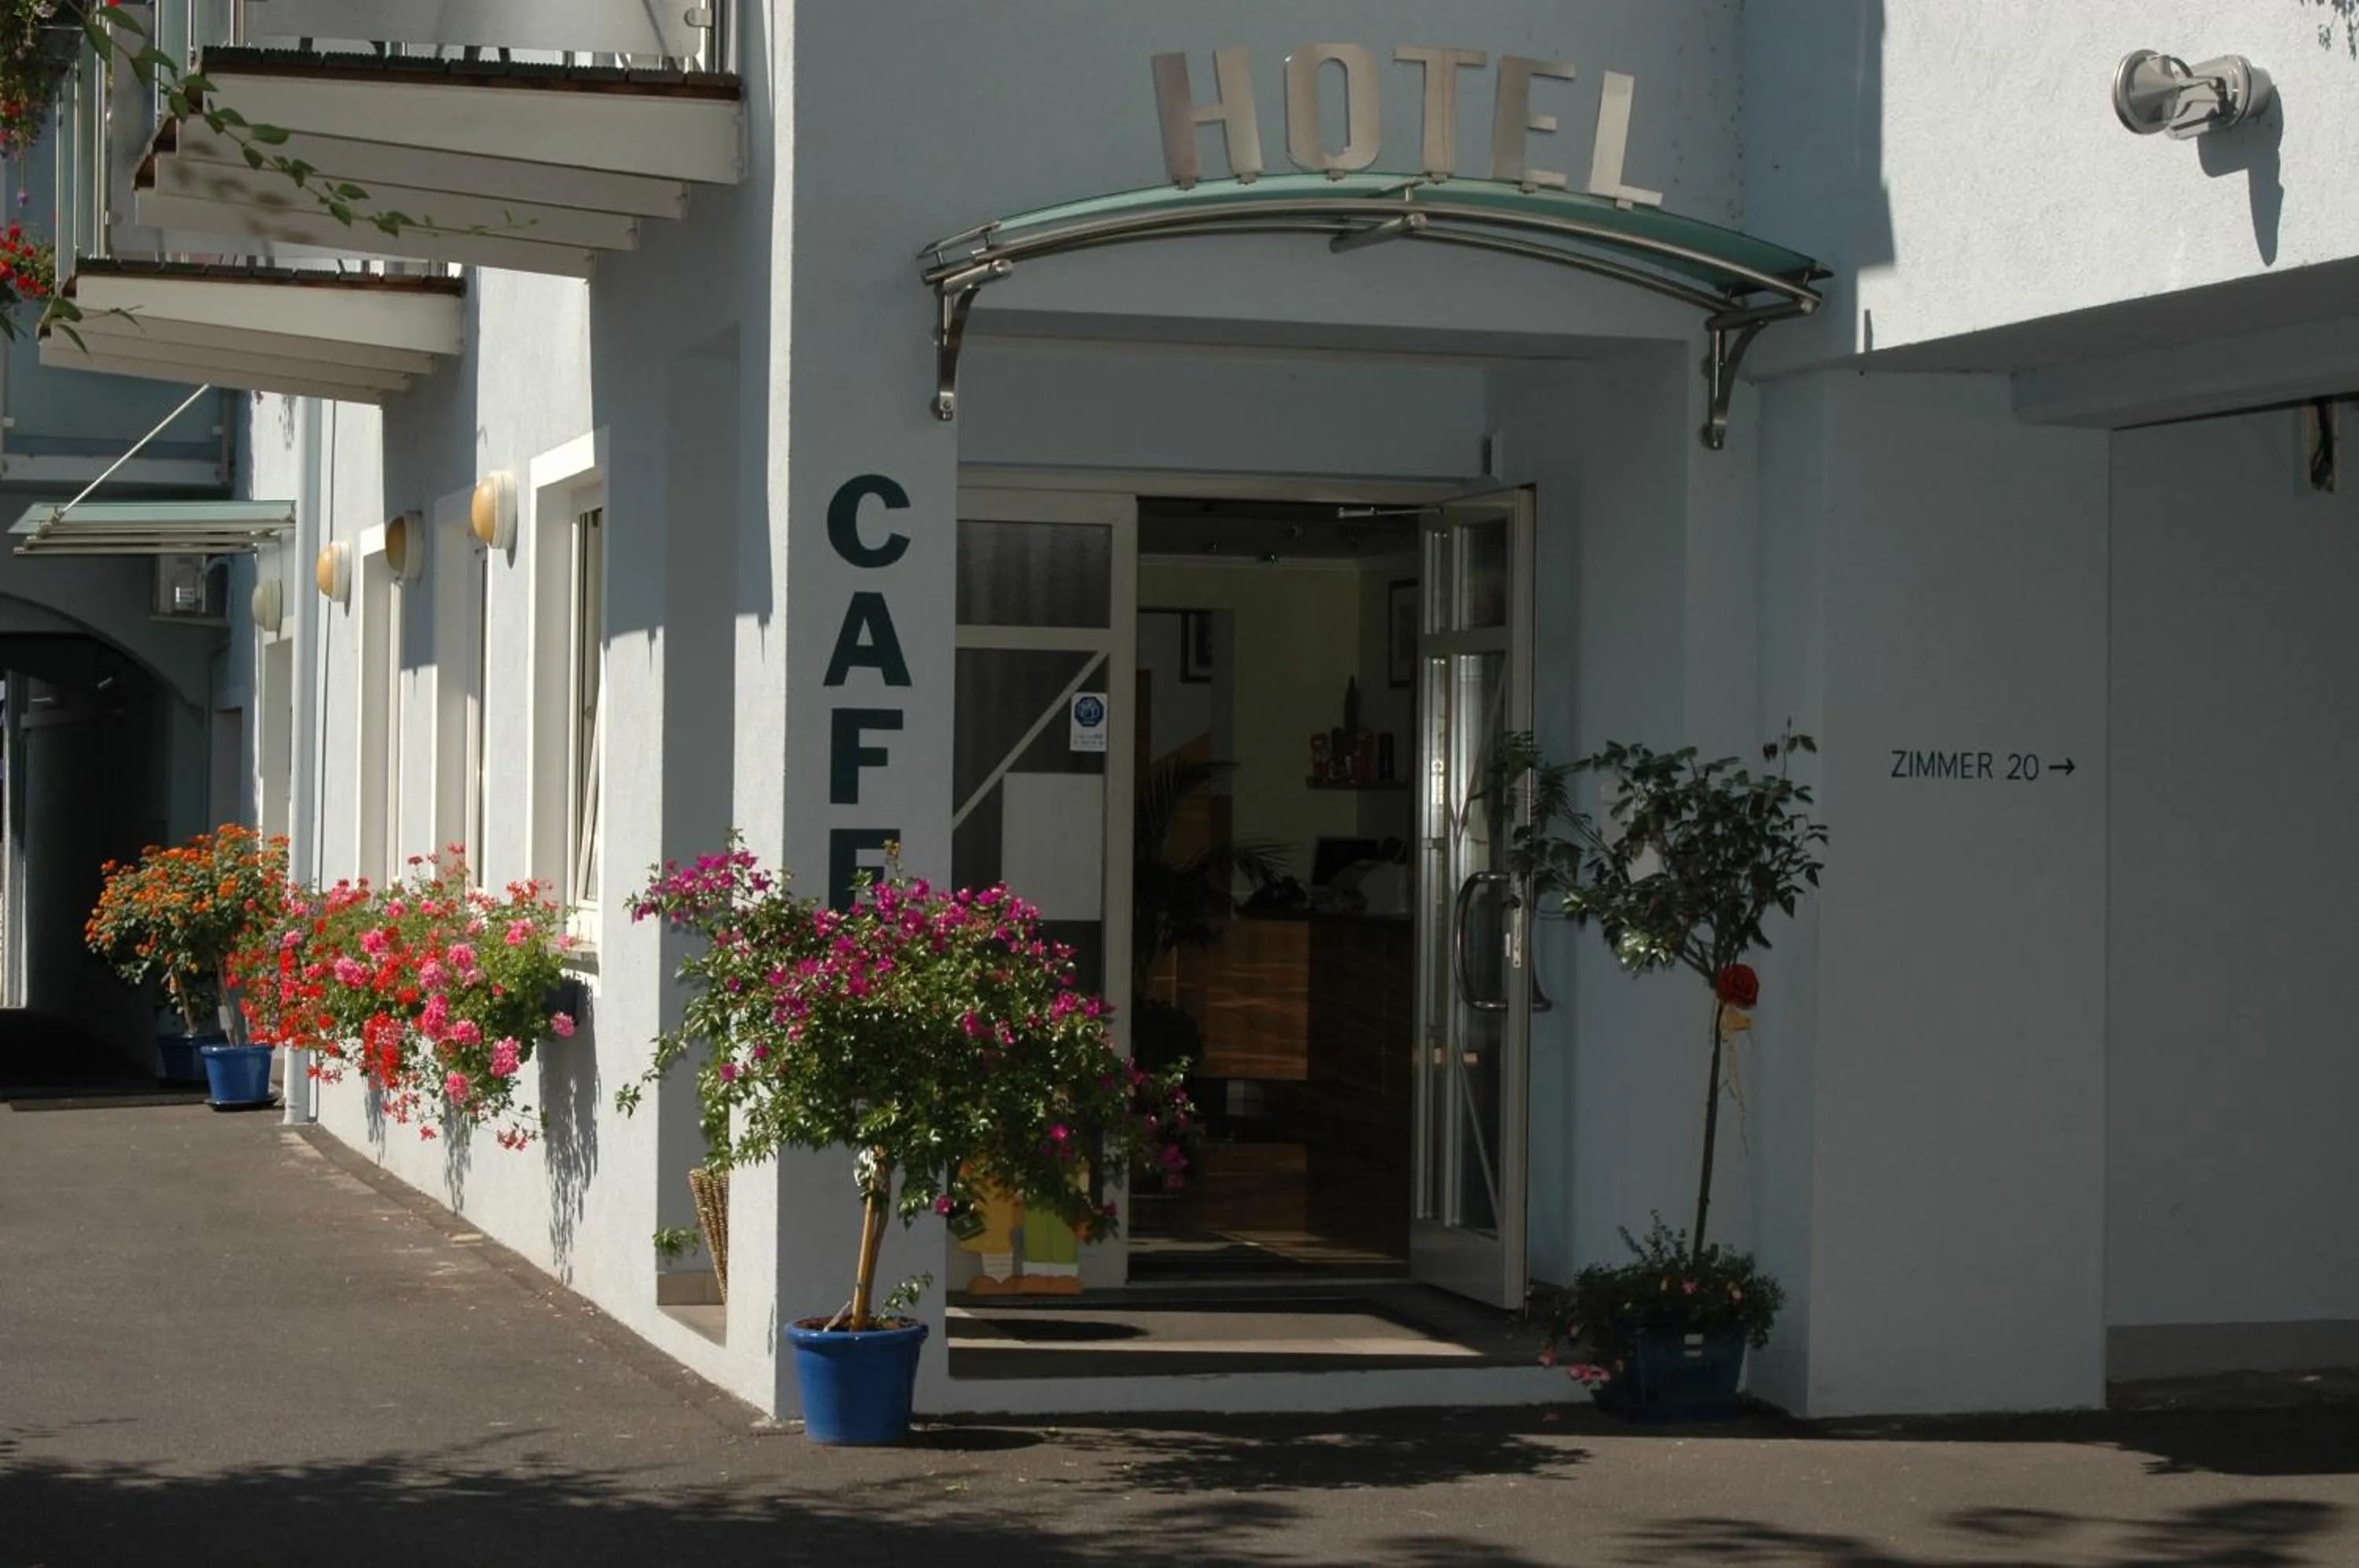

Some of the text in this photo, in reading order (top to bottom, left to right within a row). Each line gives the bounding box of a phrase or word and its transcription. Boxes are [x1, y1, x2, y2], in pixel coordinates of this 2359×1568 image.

[1152, 42, 1662, 205] HOTEL
[1890, 750, 2040, 781] ZIMMER 20
